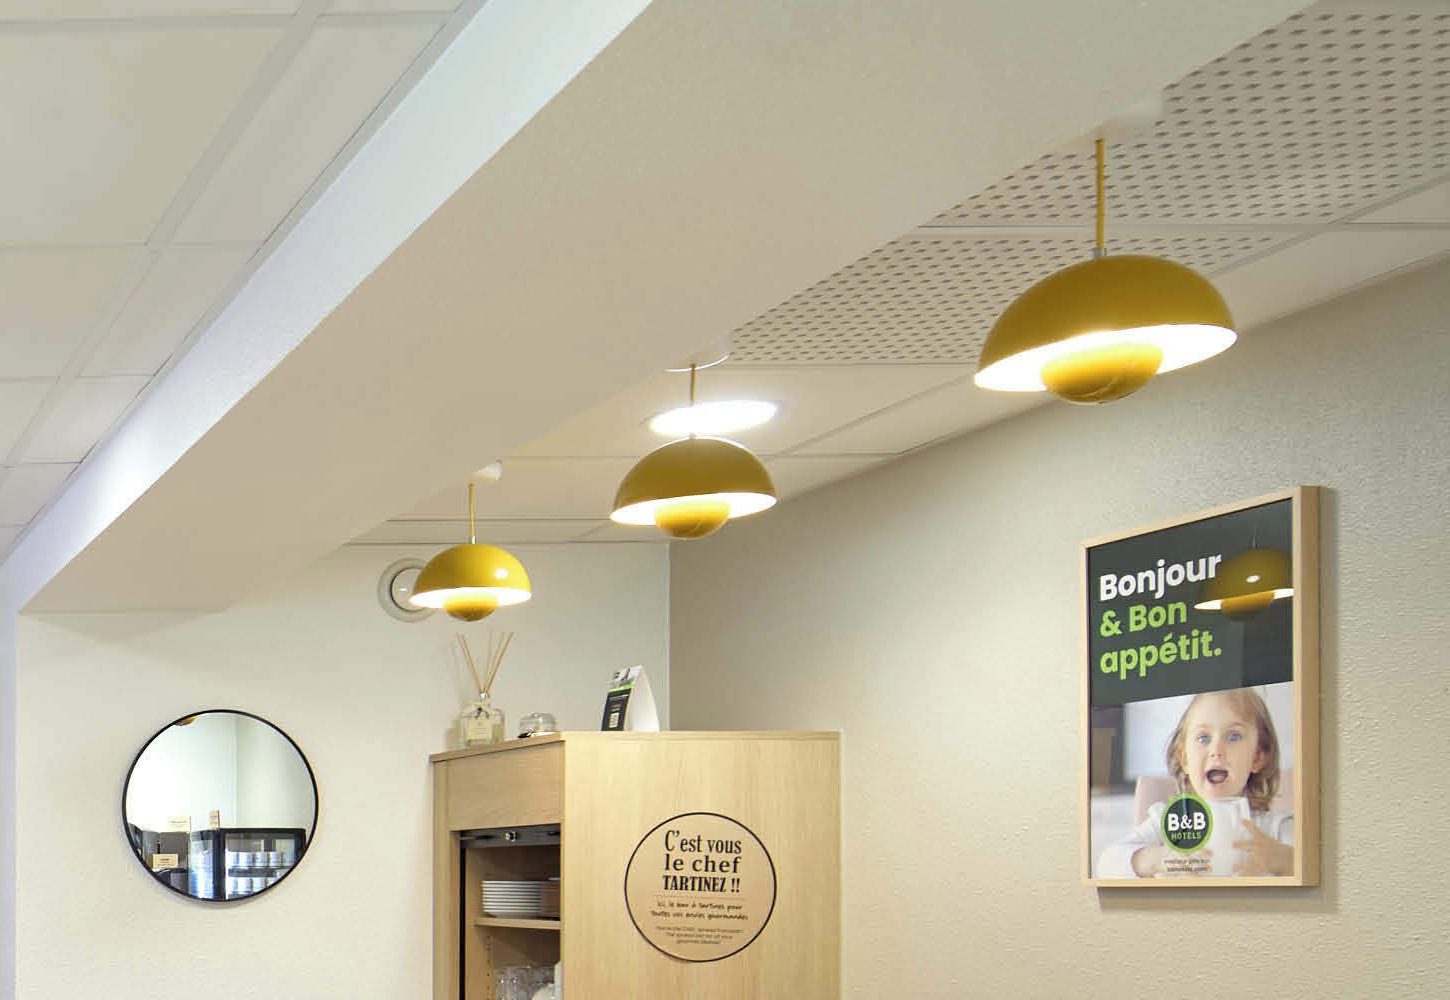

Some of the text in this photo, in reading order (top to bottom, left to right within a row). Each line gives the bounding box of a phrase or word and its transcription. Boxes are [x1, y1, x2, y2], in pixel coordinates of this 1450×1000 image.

[1100, 554, 1222, 602] Bonjour
[1100, 601, 1187, 637] & Bon
[1100, 628, 1222, 680] appétit.
[1167, 812, 1206, 831] B&B
[665, 829, 742, 854] C'est vous
[1171, 832, 1202, 840] HOTELS
[664, 853, 742, 873] le chef
[662, 875, 726, 892] TARTINEZ
